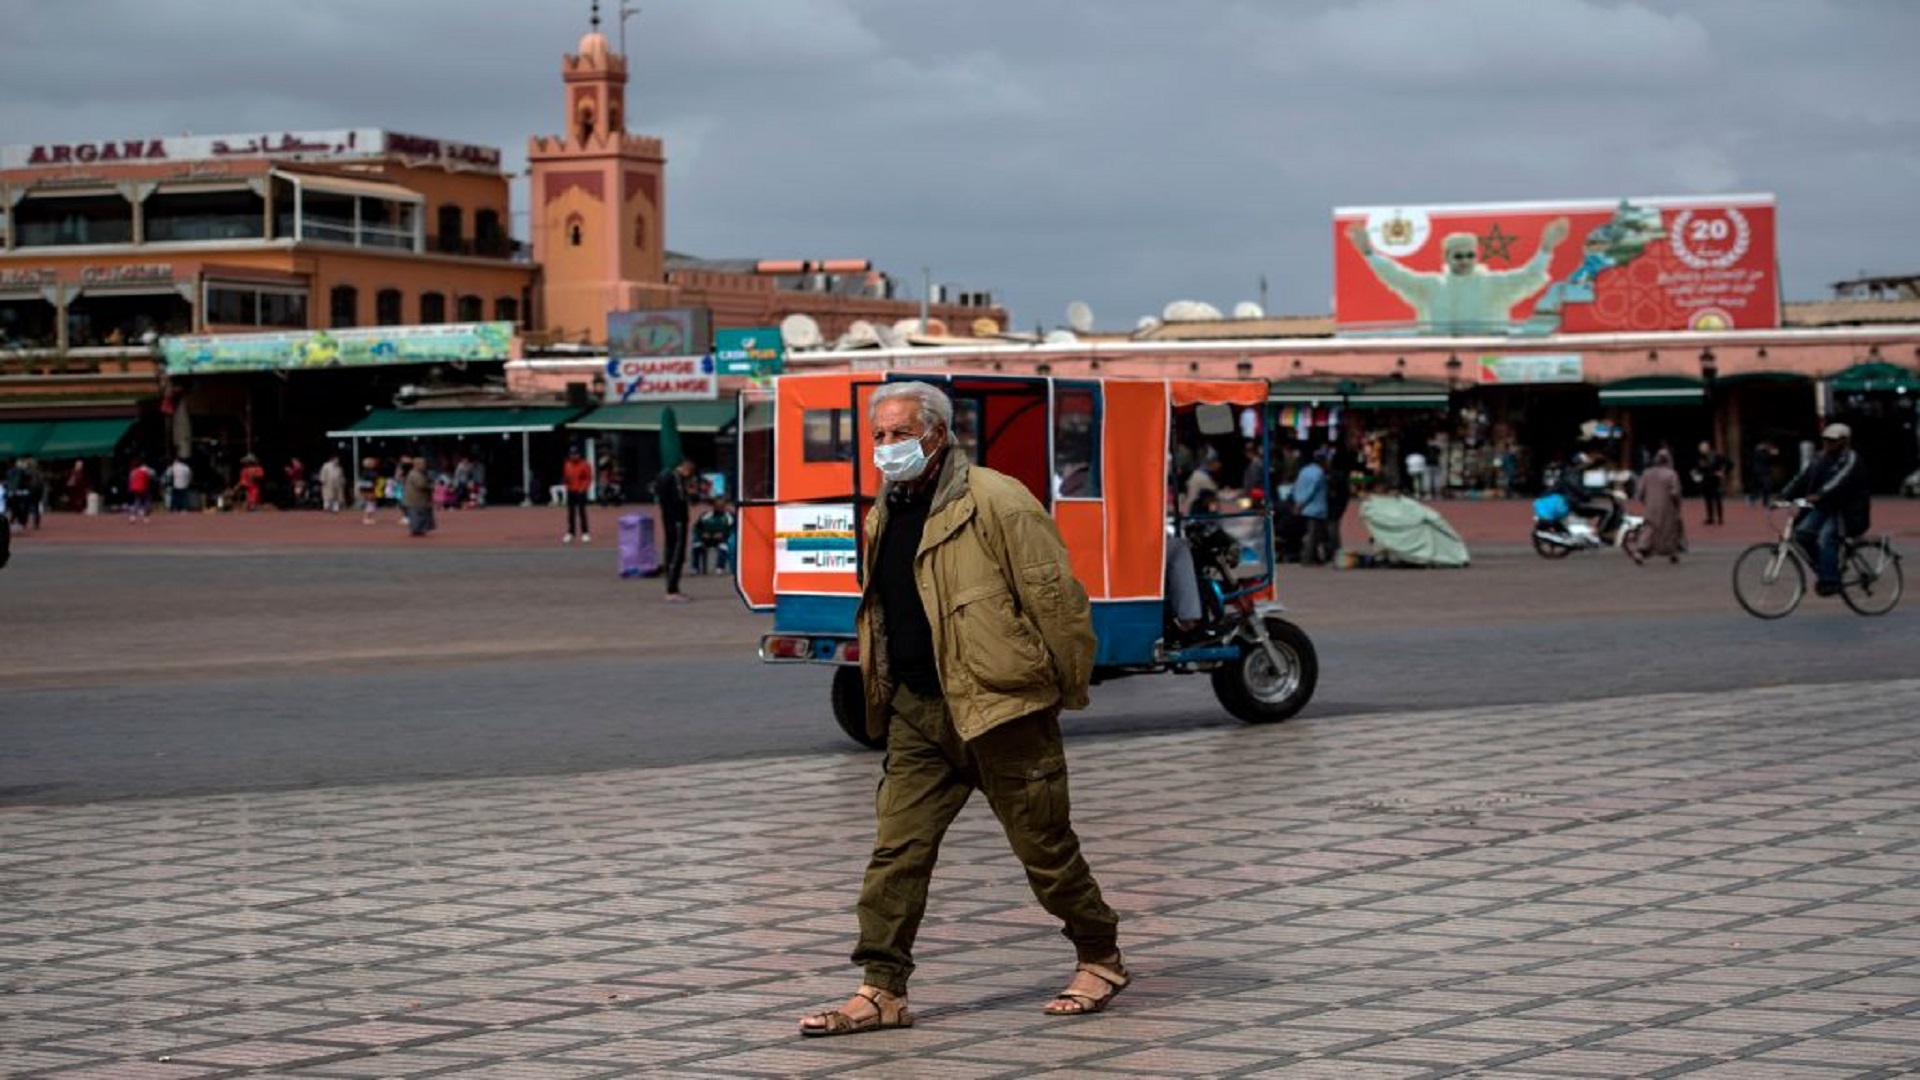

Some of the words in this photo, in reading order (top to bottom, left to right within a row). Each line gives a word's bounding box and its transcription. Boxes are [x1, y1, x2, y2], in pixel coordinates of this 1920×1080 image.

[27, 139, 168, 164] ARGANA
[1690, 218, 1729, 241] 20
[623, 358, 694, 376] CHANGE
